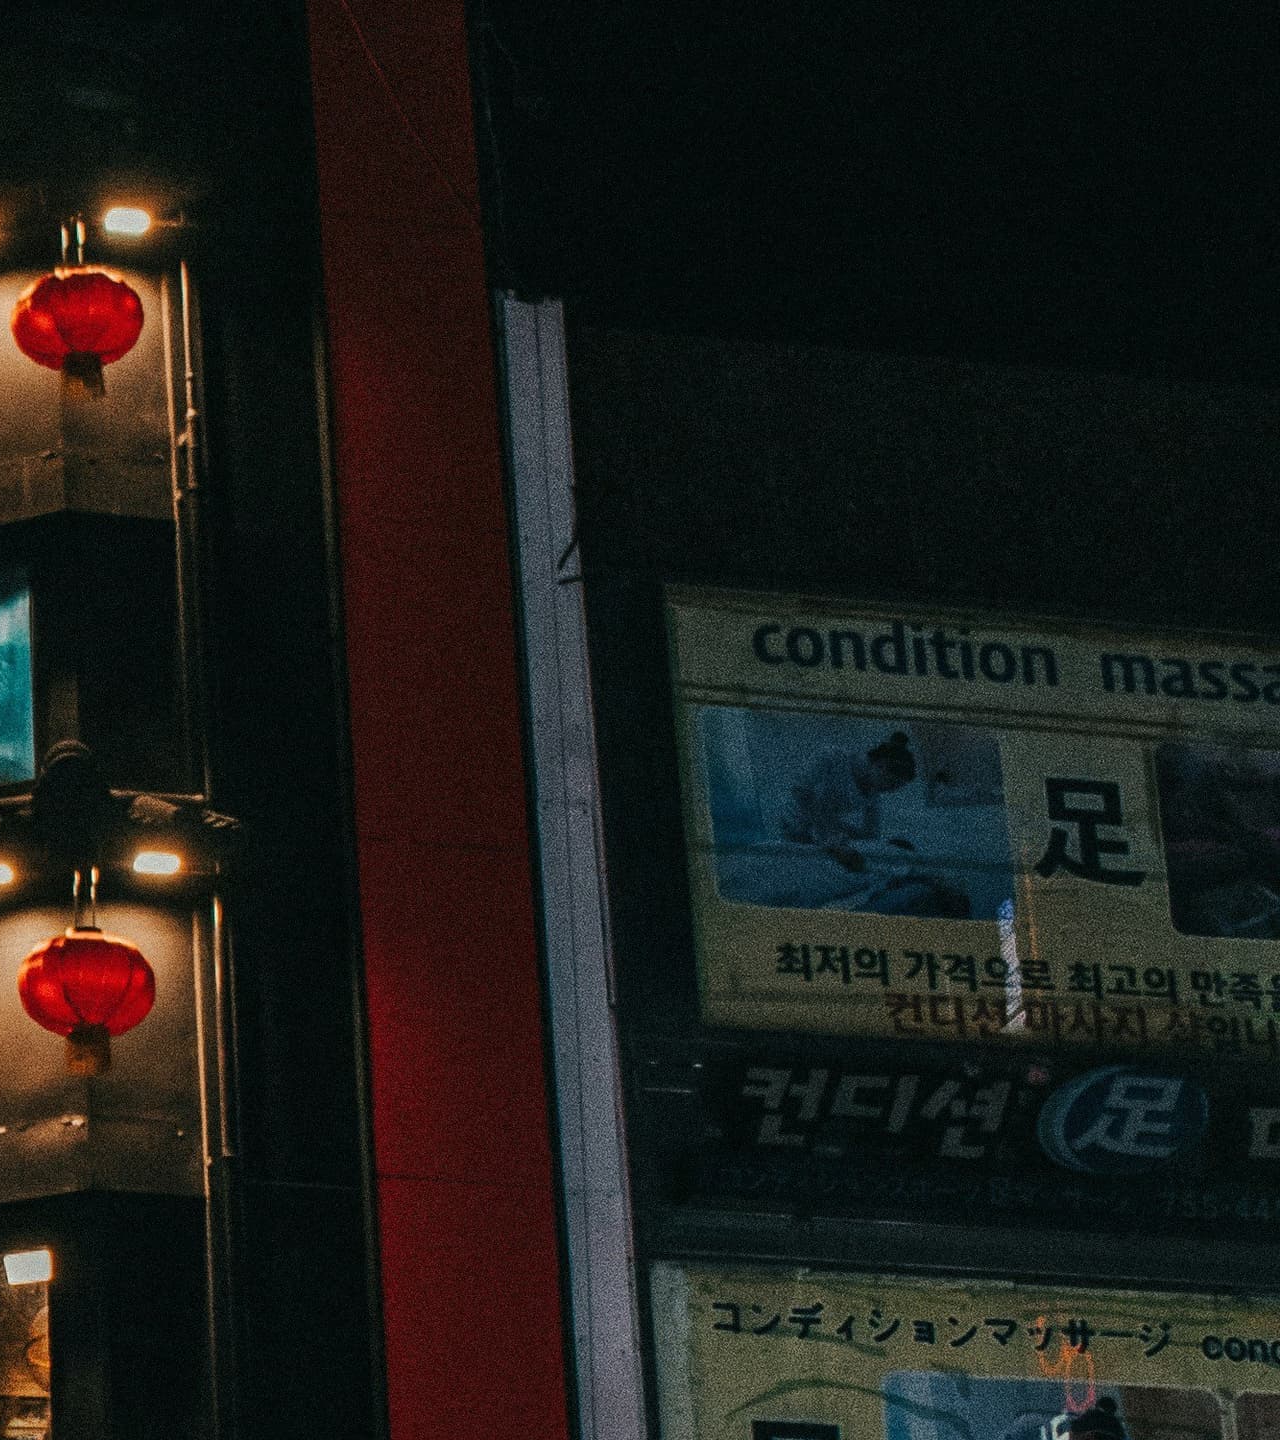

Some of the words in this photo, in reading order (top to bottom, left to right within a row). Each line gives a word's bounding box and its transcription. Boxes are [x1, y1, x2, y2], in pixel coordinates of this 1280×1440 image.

[752, 620, 1059, 687] condition
[1036, 777, 1146, 887] 足
[776, 943, 889, 986] 최저의
[1068, 960, 1178, 1005] 최고의
[742, 1066, 1012, 1159] 컨디션
[1072, 1075, 1184, 1157] 足
[712, 1301, 1171, 1359] コンディションマッサージ
